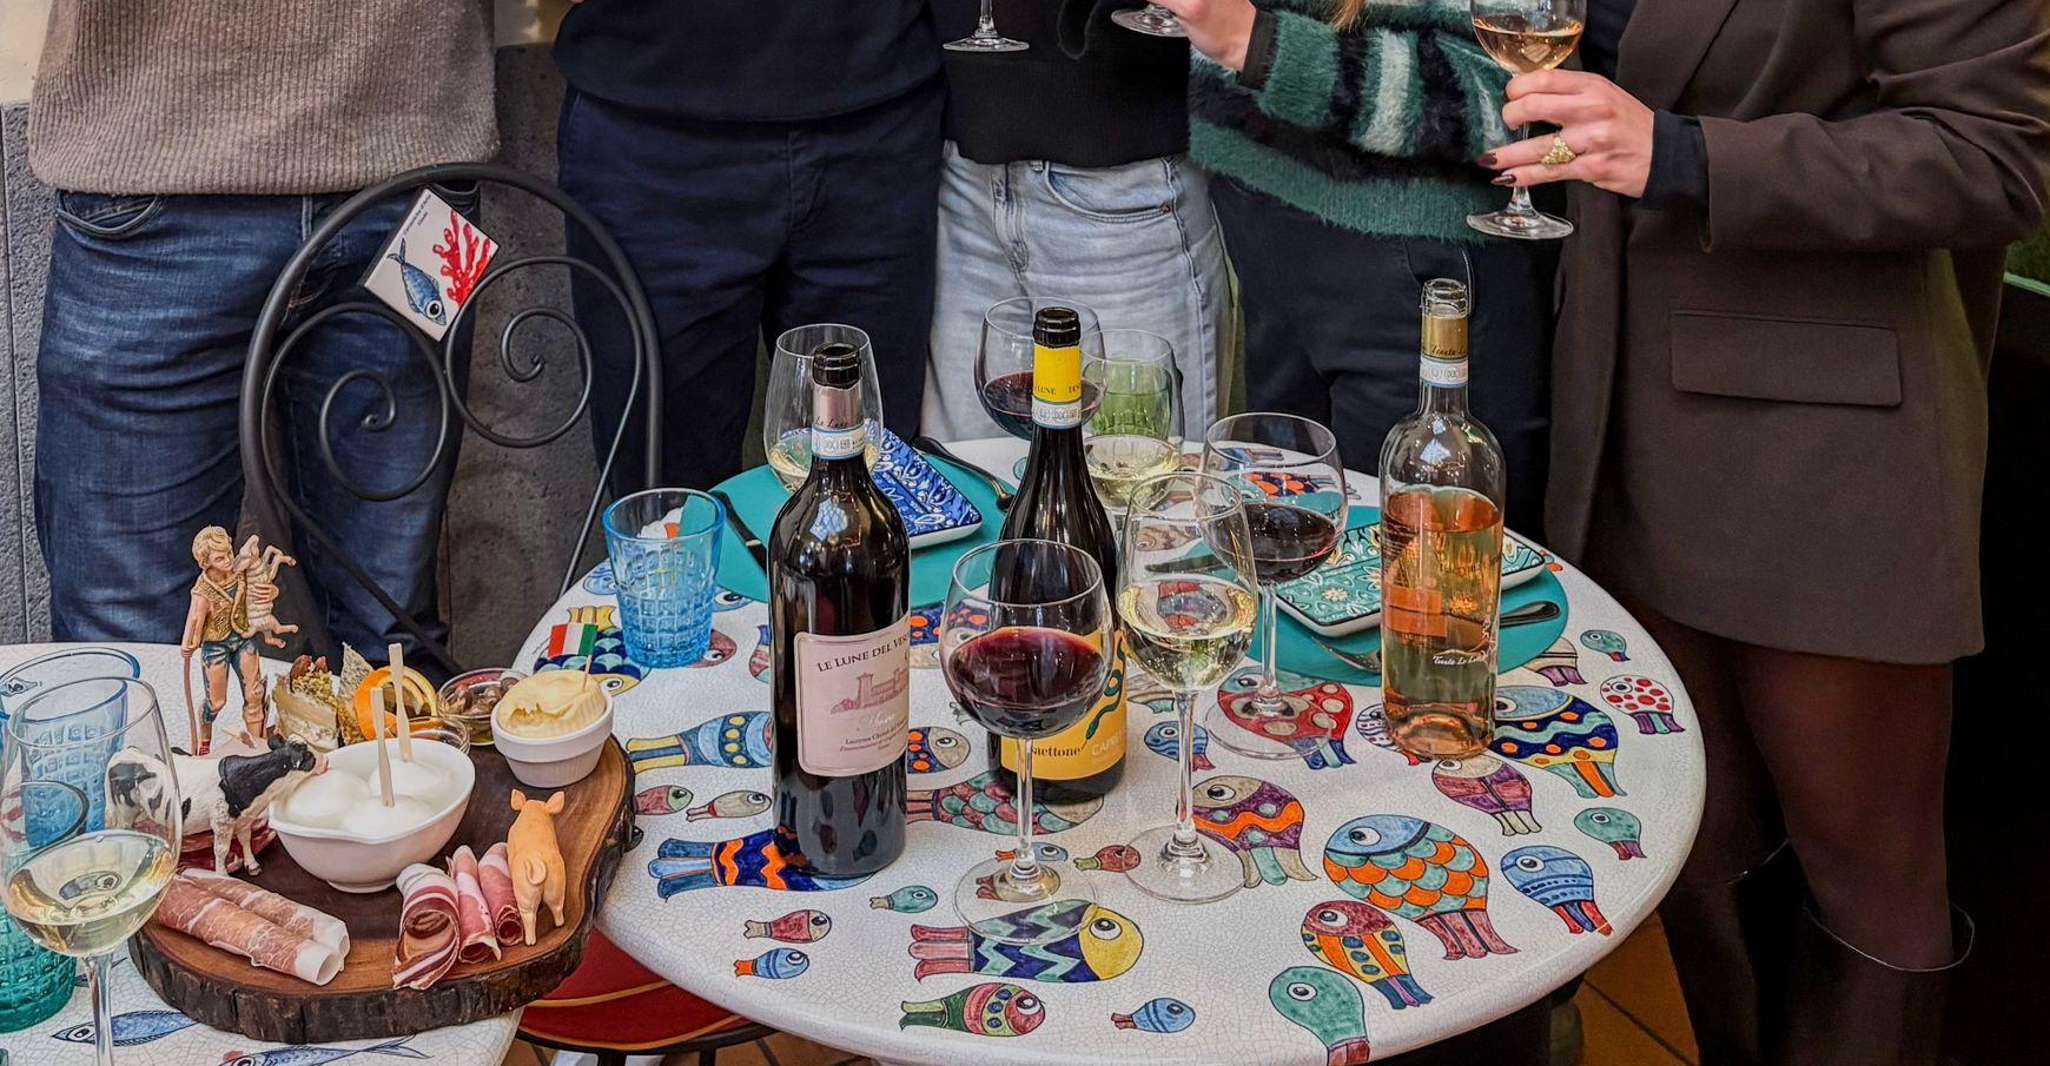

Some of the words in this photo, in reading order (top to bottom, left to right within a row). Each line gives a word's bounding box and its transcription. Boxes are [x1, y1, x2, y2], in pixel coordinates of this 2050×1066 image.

[817, 660, 833, 673] LE
[834, 651, 869, 668] LUNE
[872, 643, 893, 657] DEL
